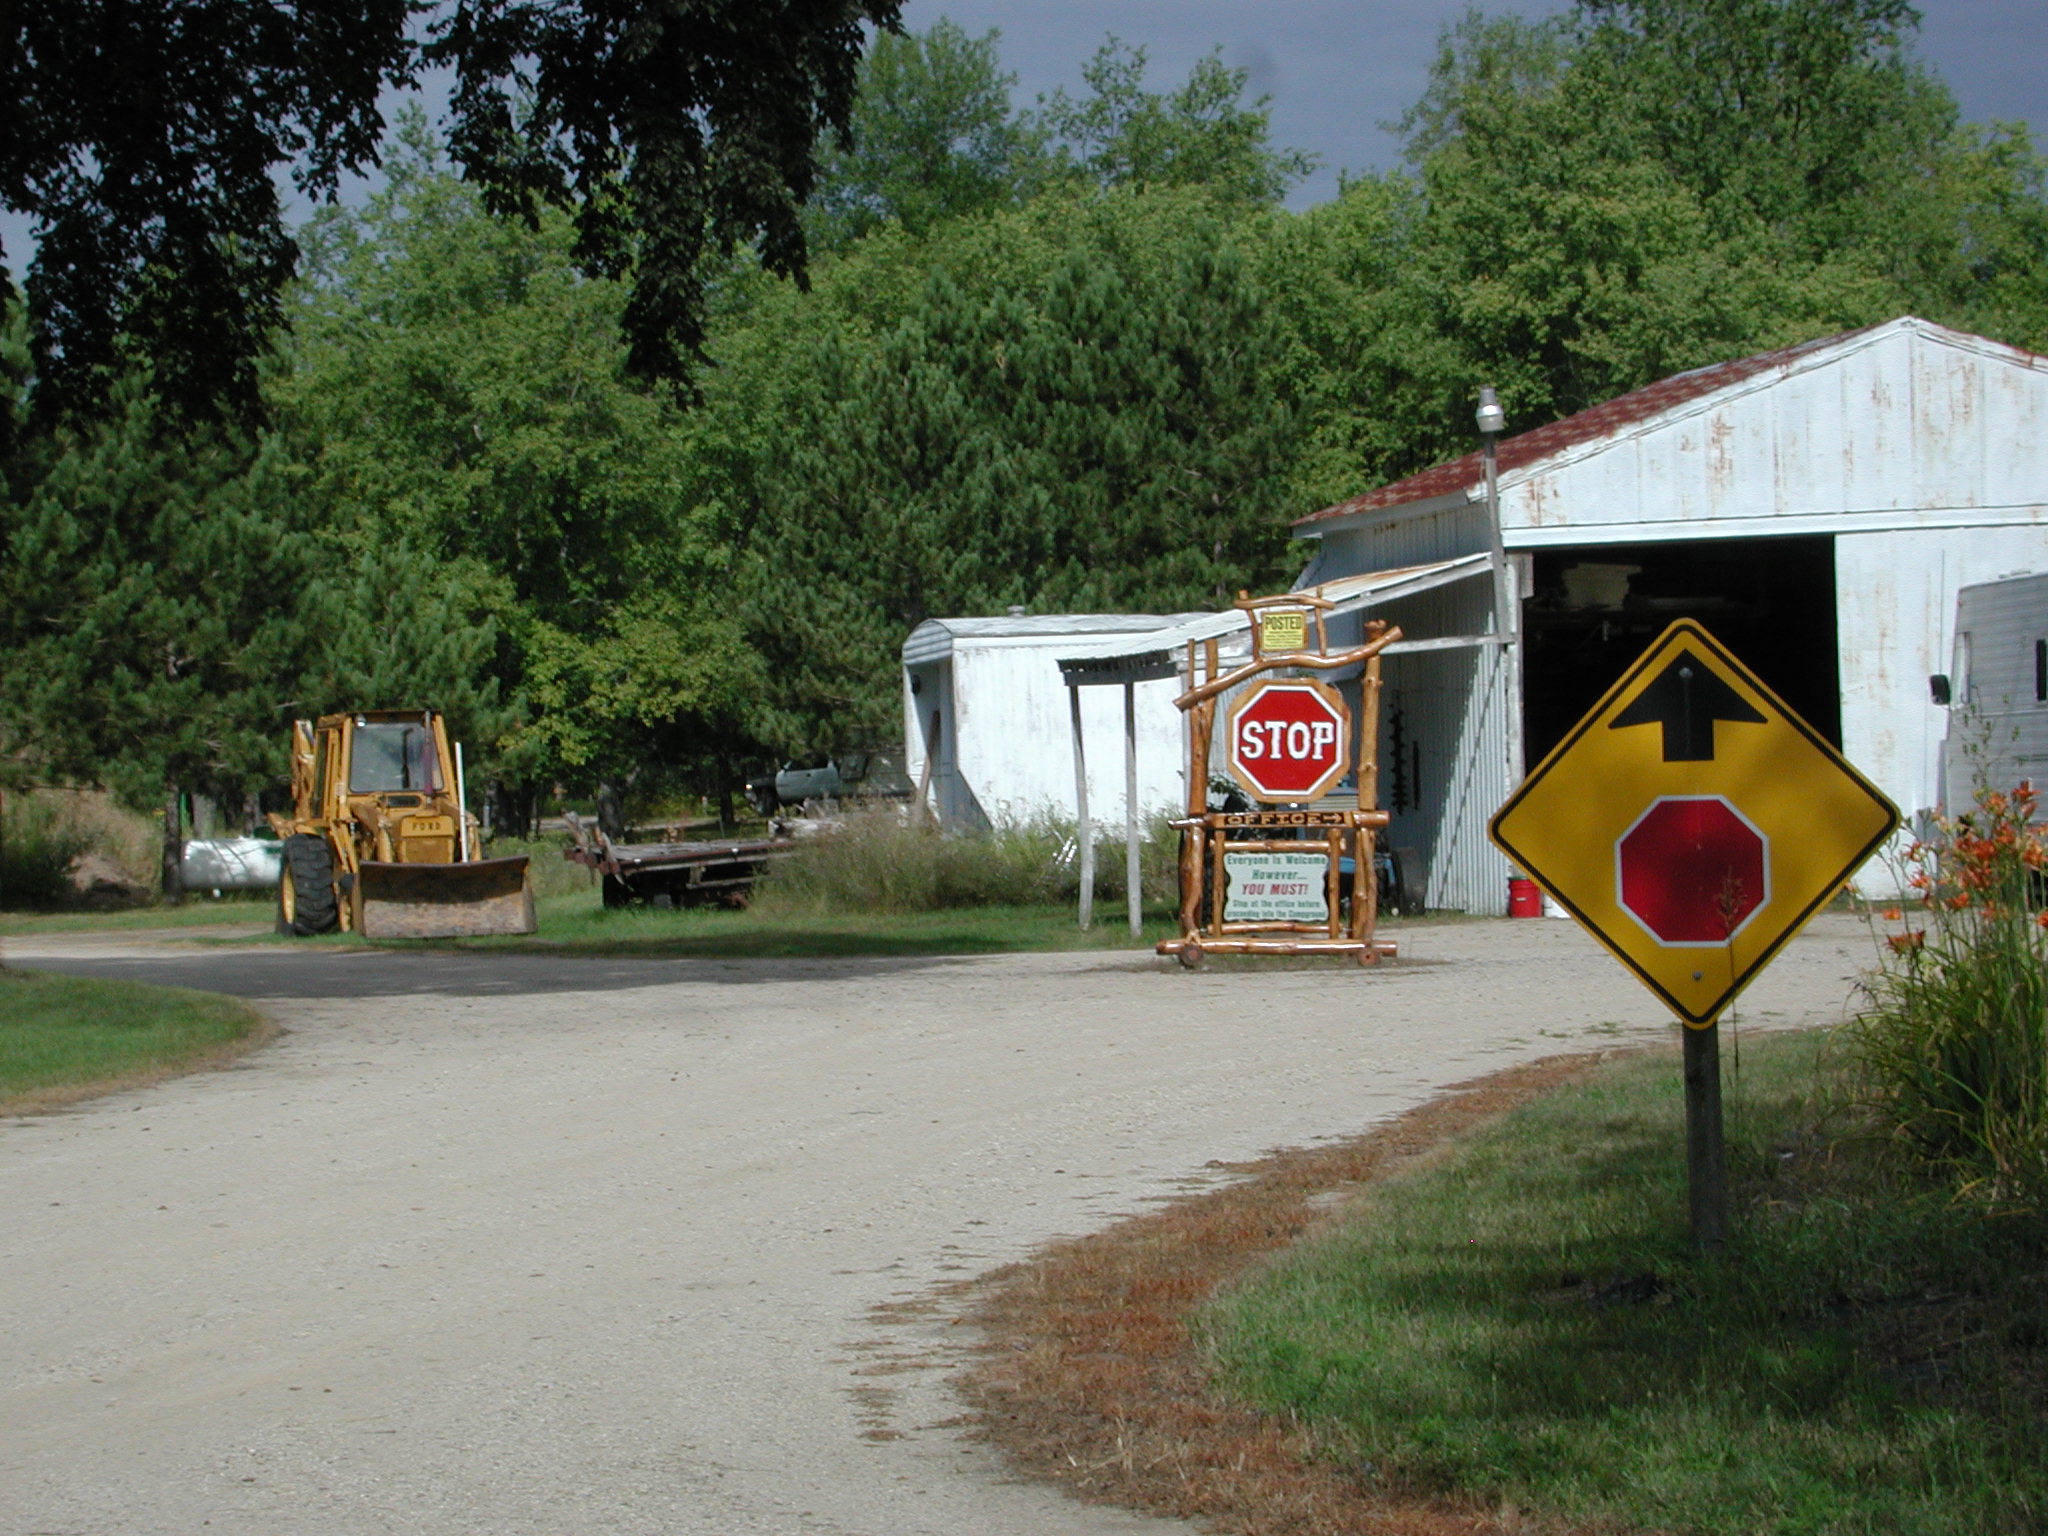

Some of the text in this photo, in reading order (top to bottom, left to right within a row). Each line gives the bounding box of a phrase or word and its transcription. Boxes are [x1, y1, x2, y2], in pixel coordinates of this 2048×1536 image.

[1265, 616, 1301, 630] POSTED
[1241, 720, 1335, 760] STOP
[1226, 813, 1322, 825] OFFICE
[412, 822, 441, 831] FORD
[1227, 855, 1268, 866] Everyone
[1285, 855, 1326, 865] Welcome
[1242, 883, 1309, 895] YOU MUST!
[1233, 900, 1320, 909] Stop at the office before
